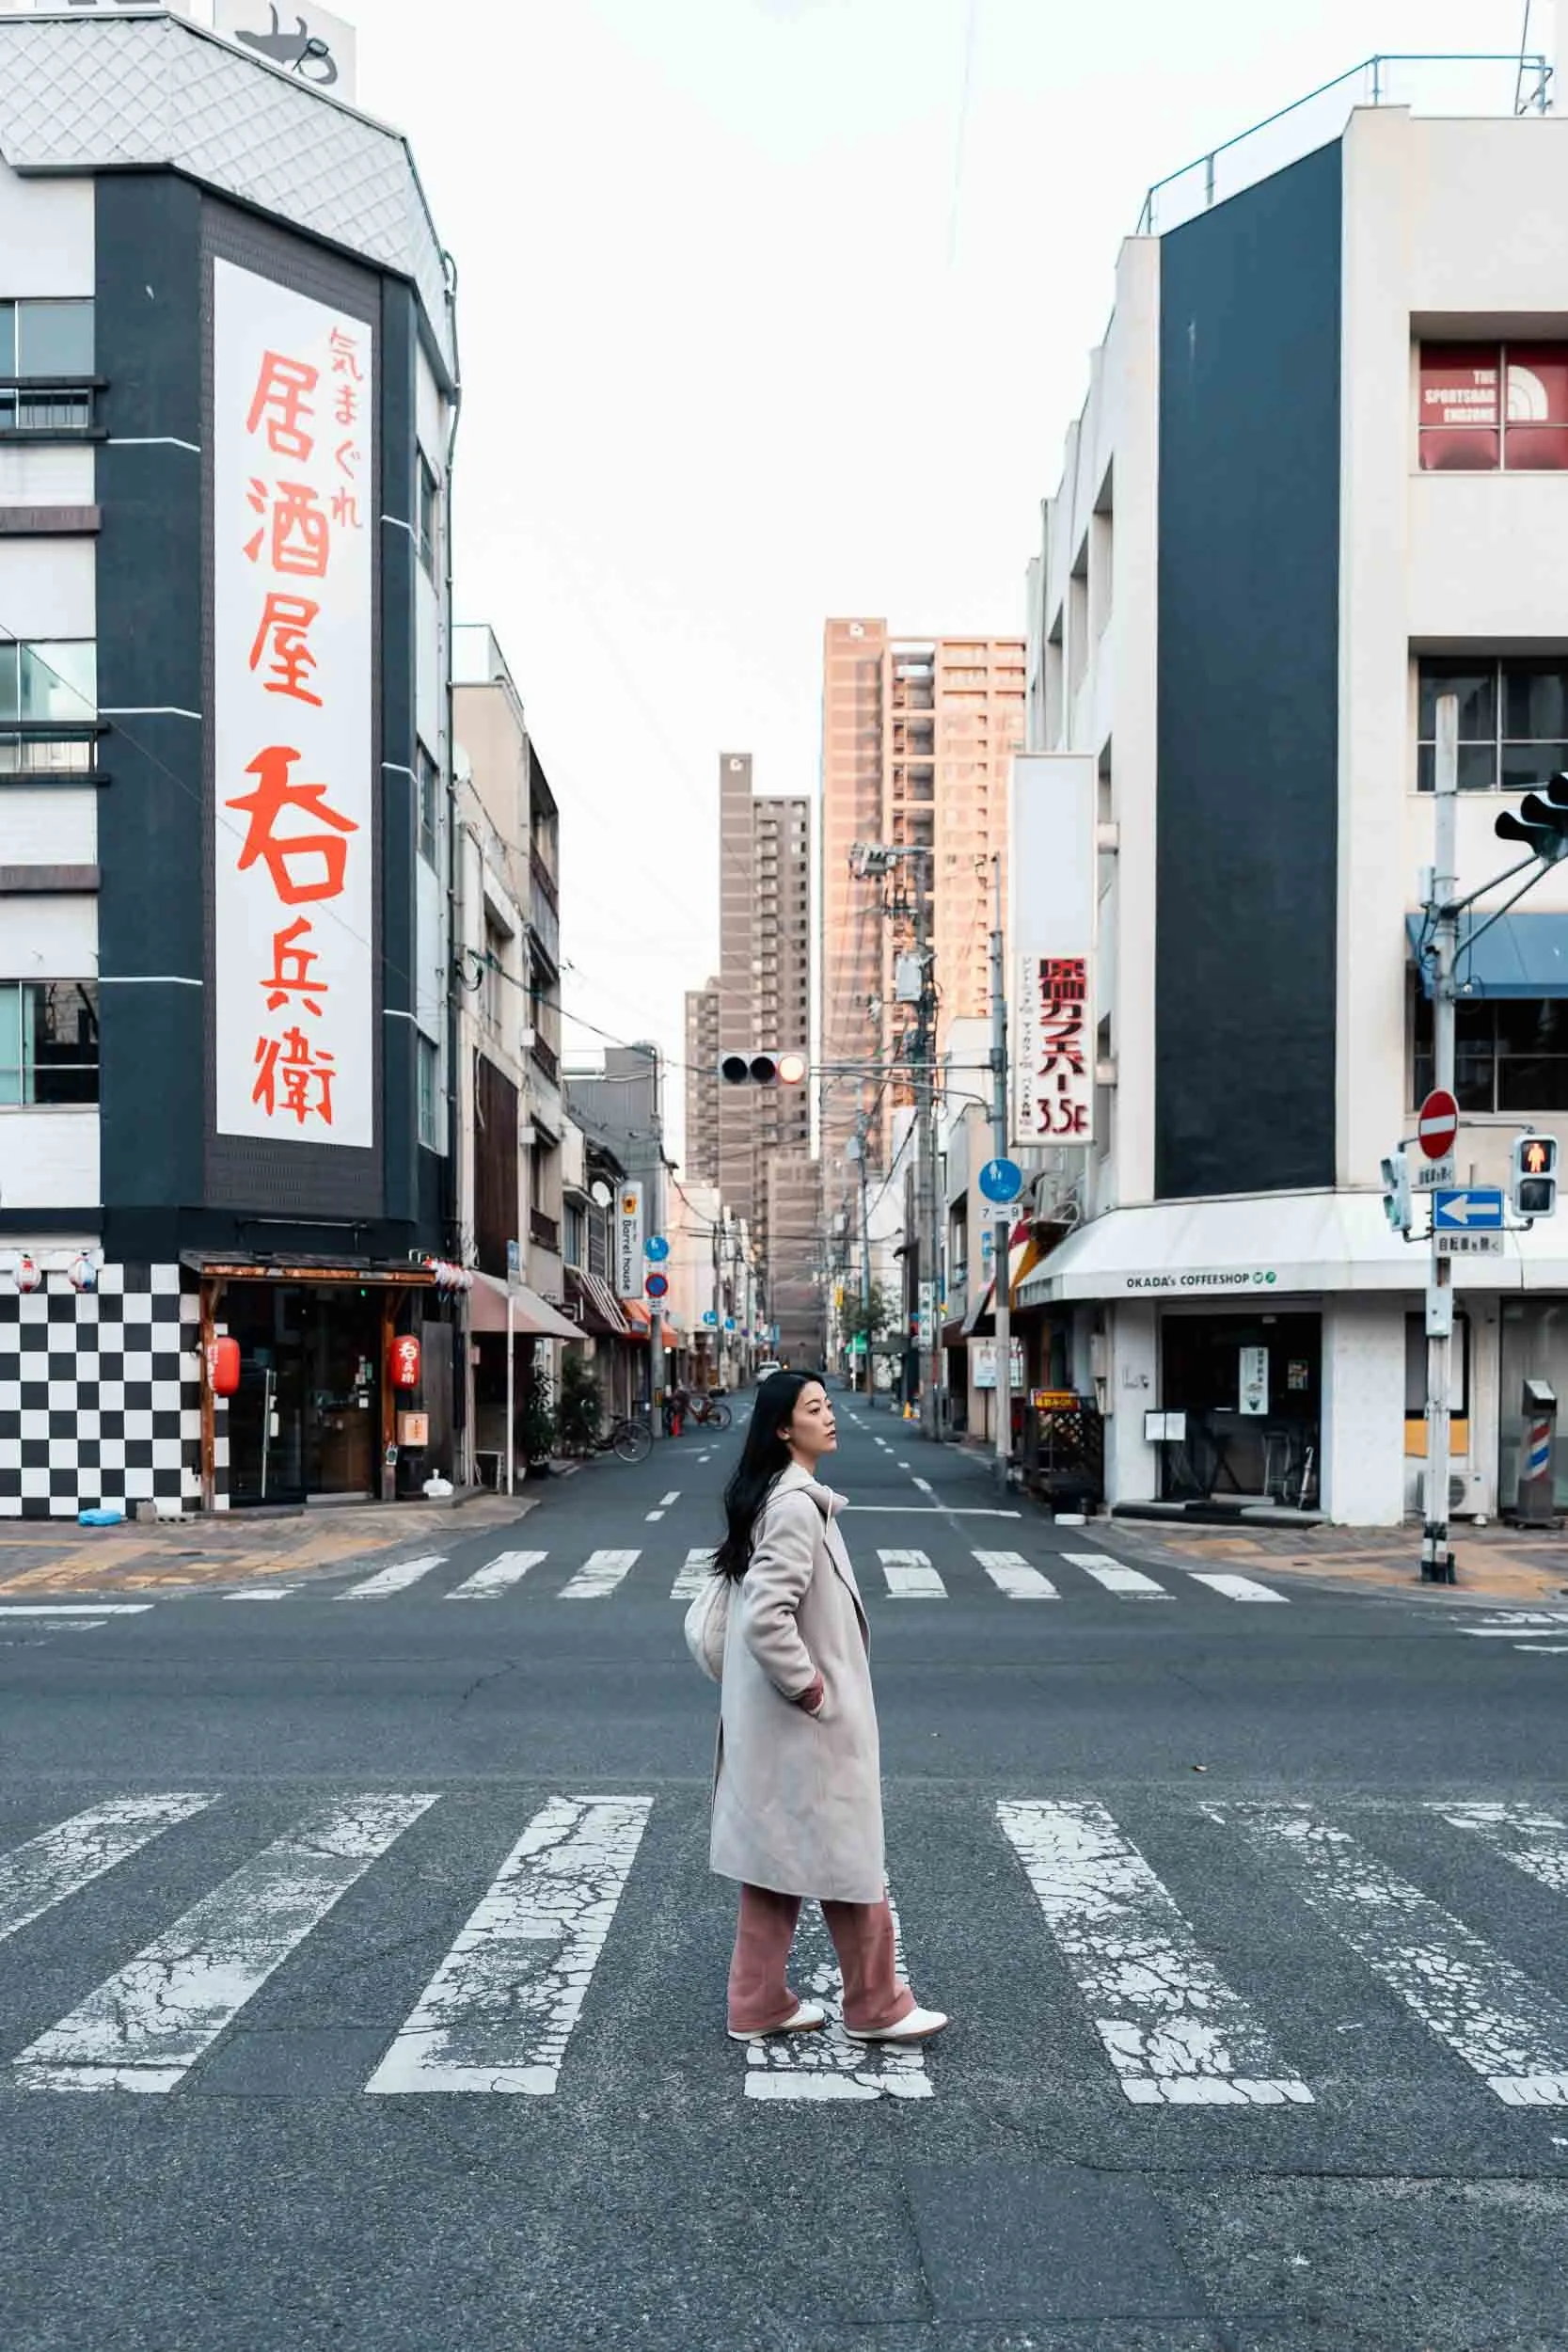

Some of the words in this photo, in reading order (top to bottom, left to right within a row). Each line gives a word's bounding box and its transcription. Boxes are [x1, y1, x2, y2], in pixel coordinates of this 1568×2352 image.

[1473, 370, 1497, 384] THE
[329, 326, 363, 529] 気まぐれ
[623, 1219, 632, 1253] Barrel
[1439, 1235, 1499, 1252] 自転車を除く
[623, 1258, 632, 1291] house
[1127, 1275, 1176, 1288] OKADA's
[1180, 1272, 1249, 1286] COFFEESHOP
